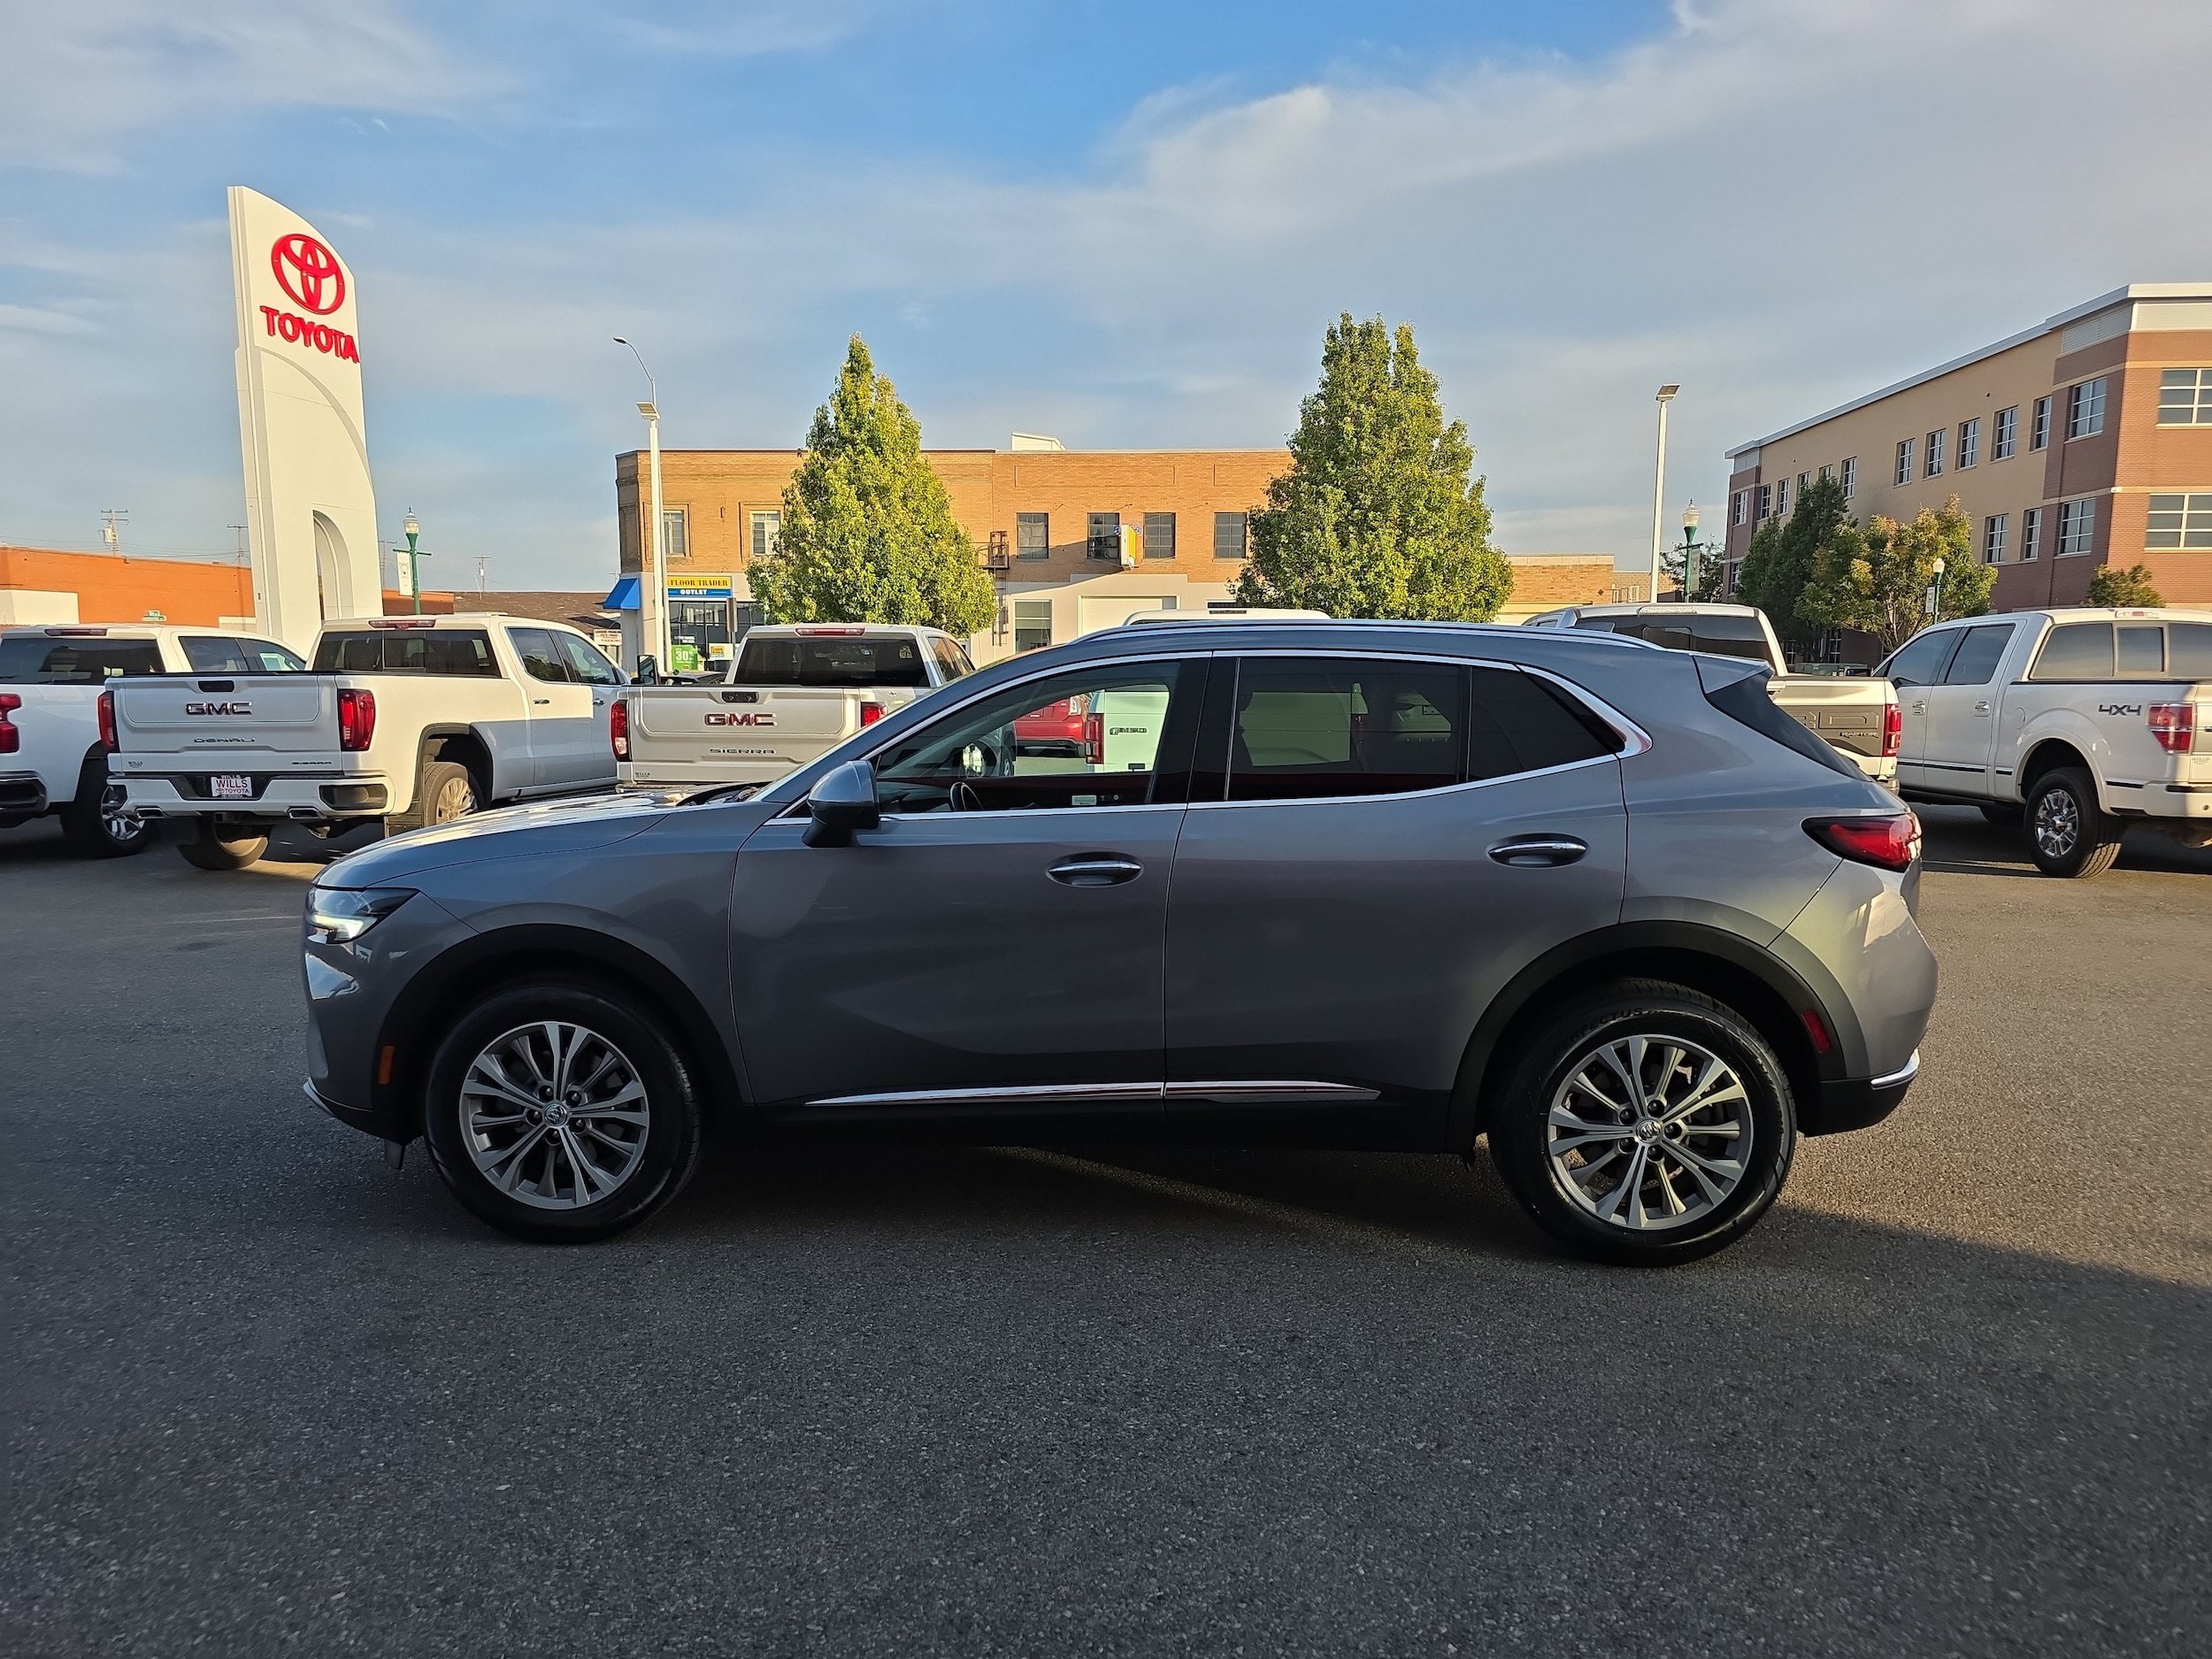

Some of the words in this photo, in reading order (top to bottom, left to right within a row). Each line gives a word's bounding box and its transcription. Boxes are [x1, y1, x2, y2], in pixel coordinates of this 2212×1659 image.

[259, 305, 360, 364] TOYOTA
[675, 650, 689, 661] 30
[186, 702, 254, 716] GMC
[2098, 704, 2142, 716] 4X4
[704, 713, 778, 726] GMC
